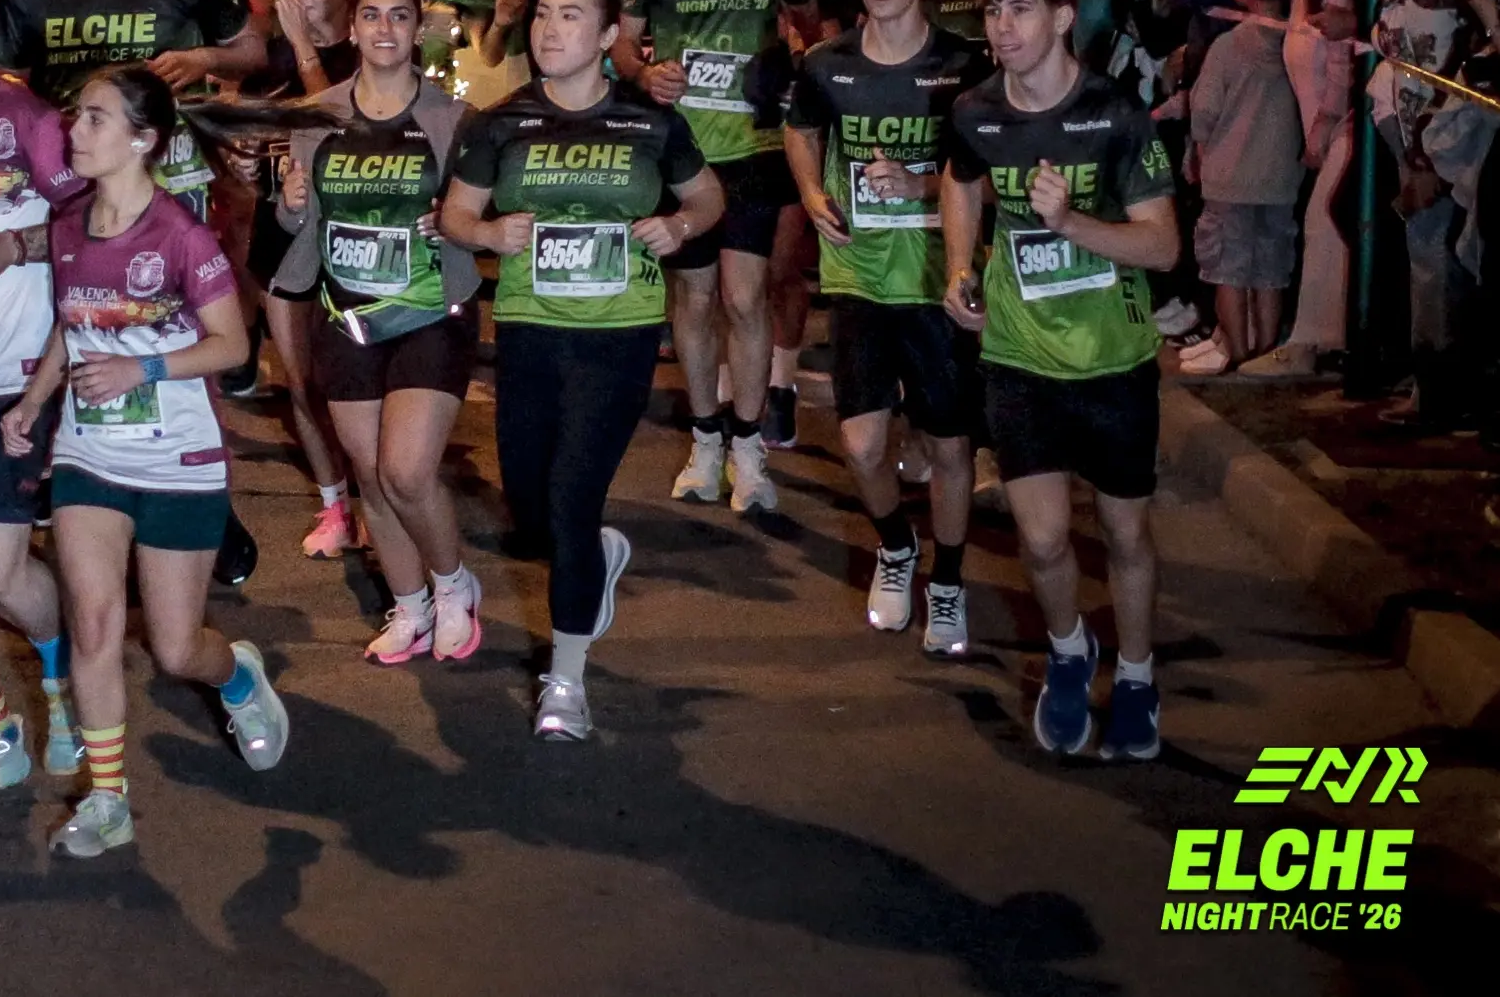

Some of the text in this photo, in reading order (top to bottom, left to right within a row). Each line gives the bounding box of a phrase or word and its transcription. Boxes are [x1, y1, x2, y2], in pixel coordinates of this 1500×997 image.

[44, 13, 157, 49] ELCHE
[841, 114, 946, 144] ELCHE
[323, 153, 428, 180] ELCHE
[524, 144, 633, 171] ELCHE
[331, 236, 378, 271] 2650
[537, 238, 595, 271] 3554
[1019, 240, 1072, 275] 3951
